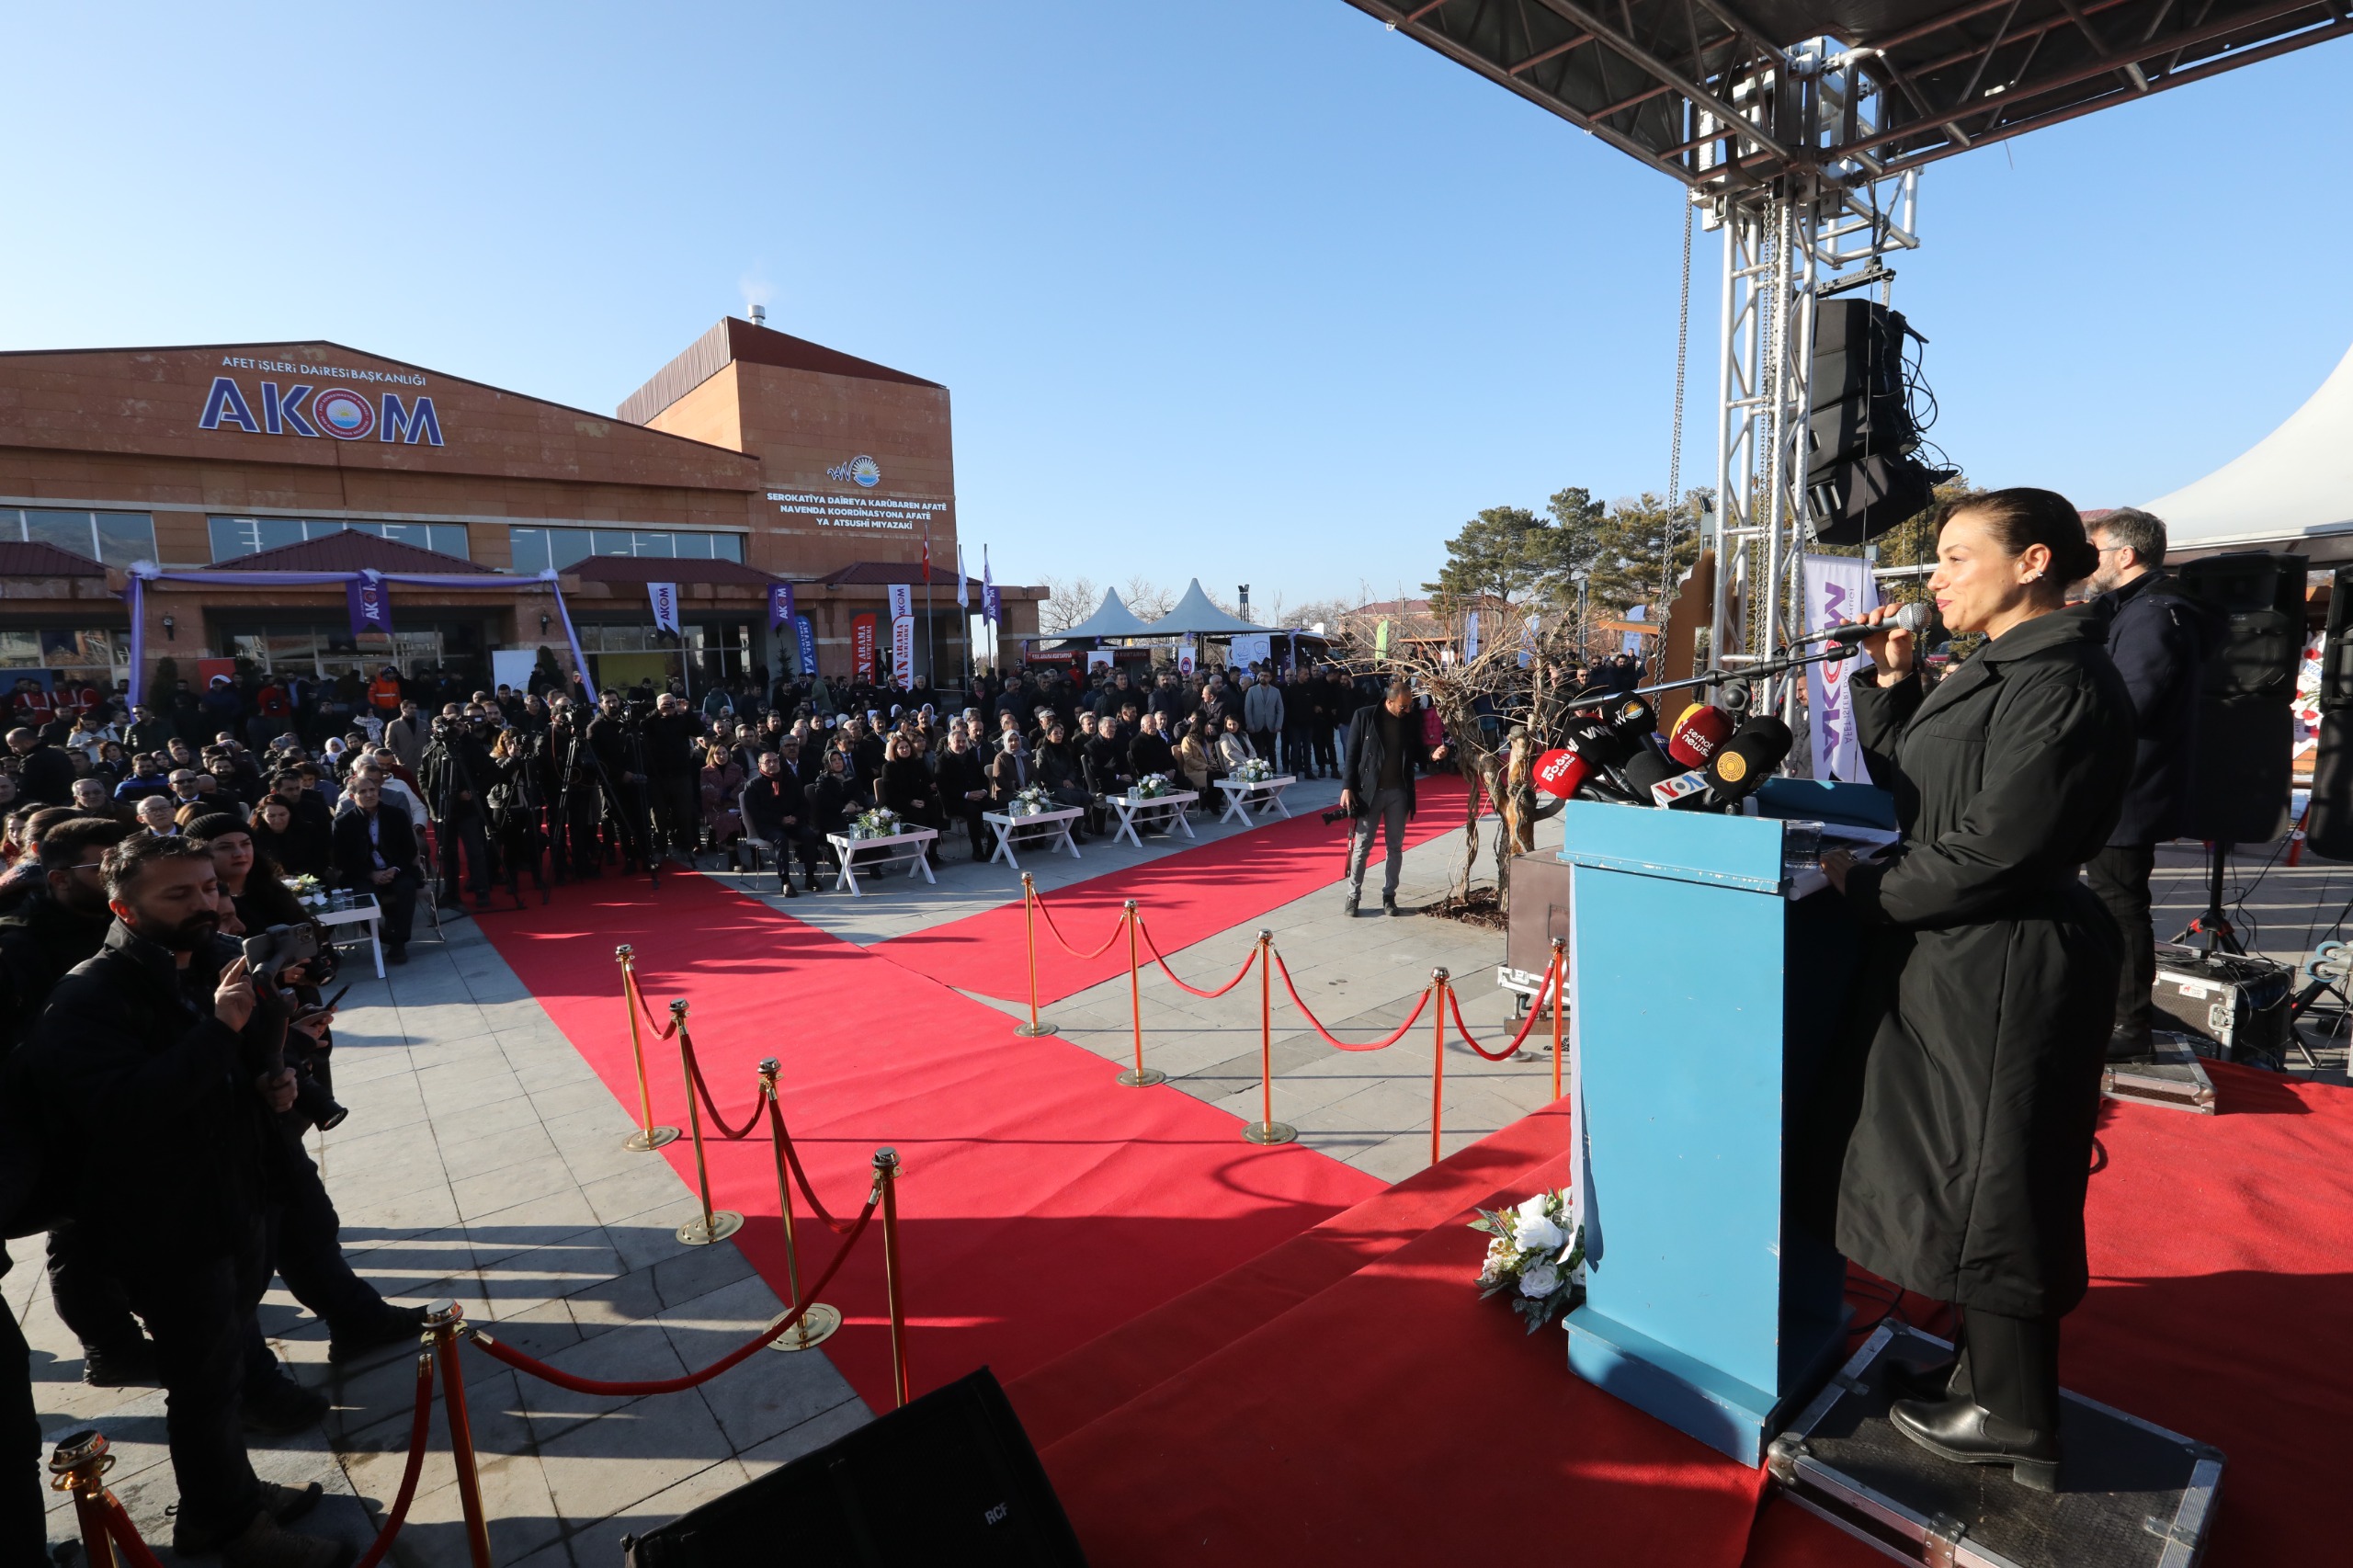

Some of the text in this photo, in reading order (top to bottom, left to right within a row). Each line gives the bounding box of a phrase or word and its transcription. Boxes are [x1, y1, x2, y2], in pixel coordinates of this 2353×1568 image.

[222, 357, 255, 369] AFET
[351, 369, 426, 386] BAŞKANLIĞI
[199, 377, 445, 447] AKOM
[767, 492, 947, 511] SEROKATÎYA DAÎREYA KARÛBAREN AFATÊ
[780, 505, 931, 520] NAVENDA KOORDÎNASYONA AFATÊ
[816, 517, 913, 530] YA ATSUSHÎ MIYAZAKÎ
[659, 587, 670, 620] AKOM
[778, 587, 789, 619] AKOM
[858, 625, 866, 660] ARAMA
[1687, 728, 1714, 751] serhat
[1545, 753, 1571, 782] DOĞU
[1655, 775, 1706, 799] VOA
[984, 1502, 1008, 1525] RCF
